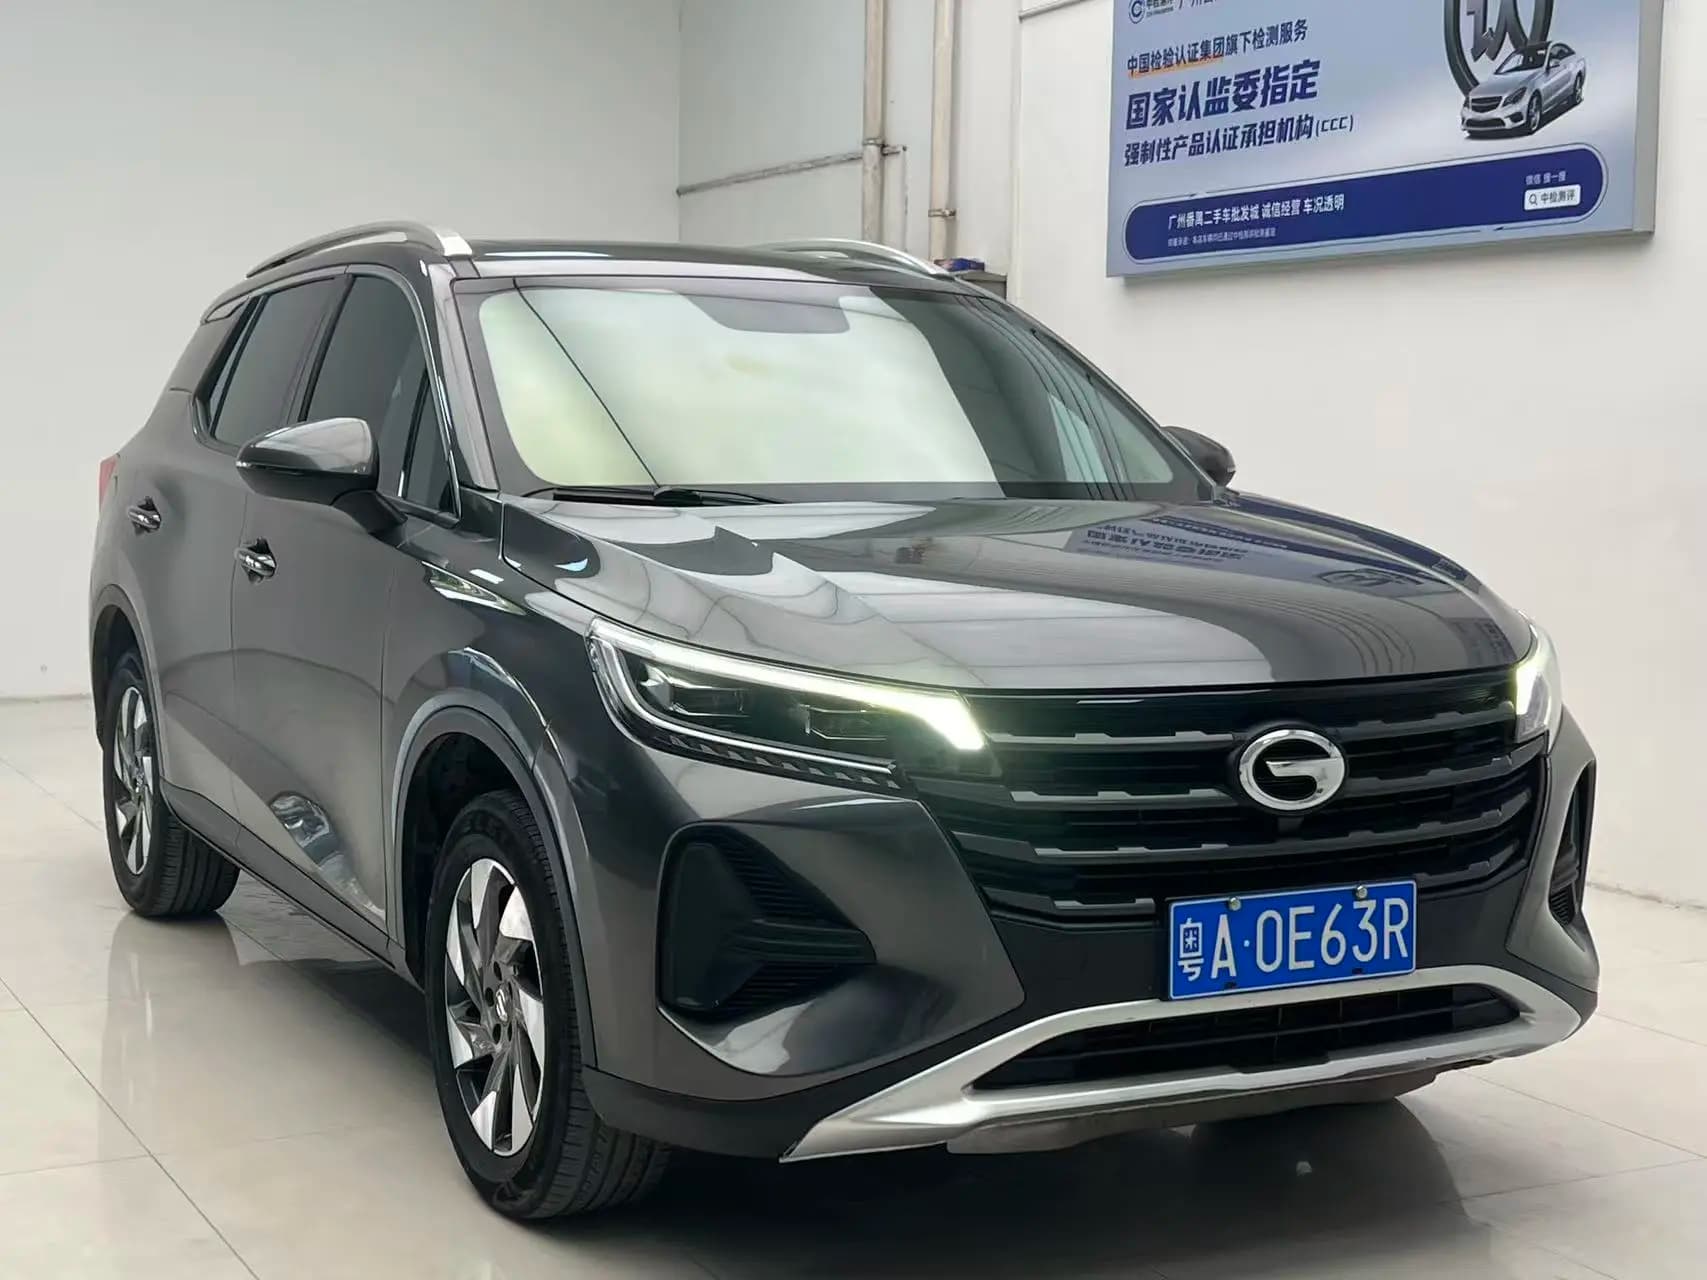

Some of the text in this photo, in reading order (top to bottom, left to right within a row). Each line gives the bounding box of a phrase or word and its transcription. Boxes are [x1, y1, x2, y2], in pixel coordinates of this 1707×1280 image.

[1127, 18, 1308, 76] 中国检验认证集团旗下检测服务
[1126, 59, 1320, 130] 国家认监委指定
[1261, 199, 1301, 219] 诚信经营
[1303, 193, 1345, 214] 车况透明
